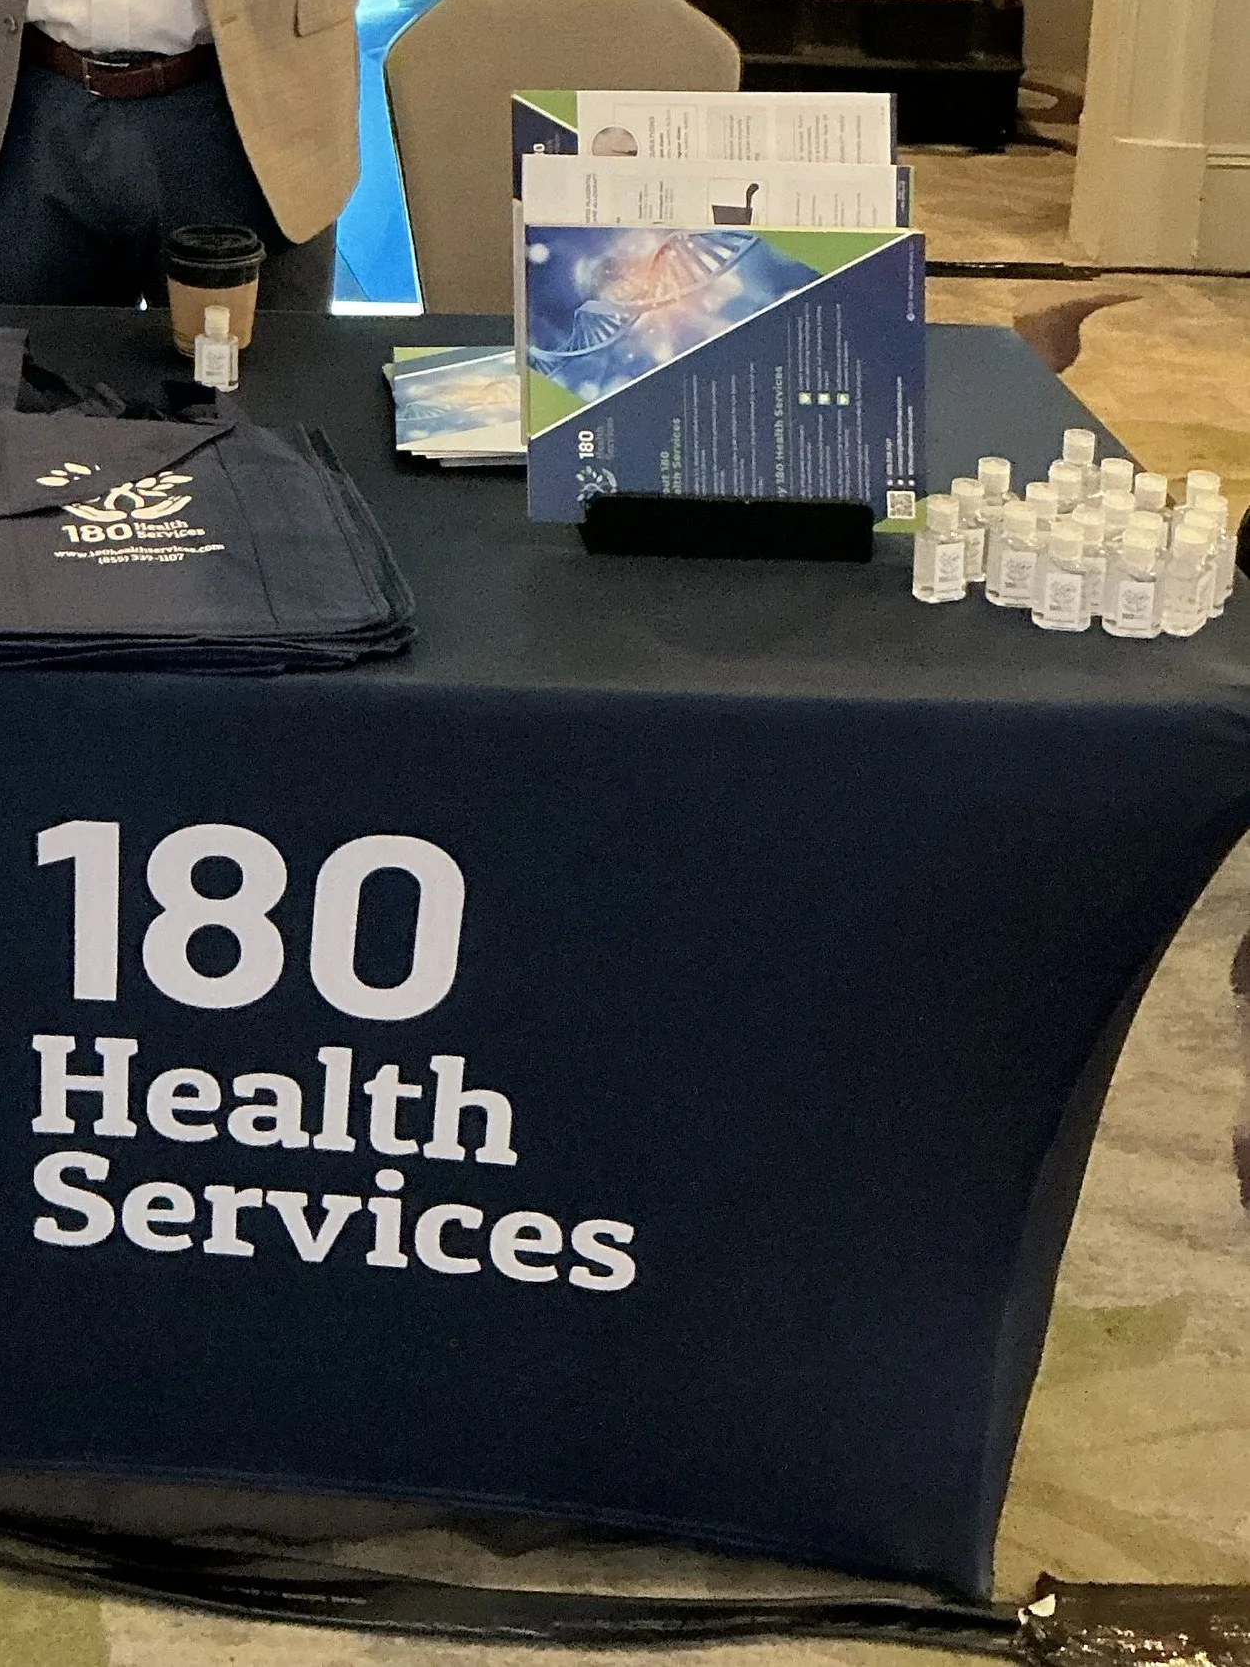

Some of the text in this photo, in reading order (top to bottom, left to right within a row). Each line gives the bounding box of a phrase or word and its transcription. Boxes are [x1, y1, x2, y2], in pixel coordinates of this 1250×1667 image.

[773, 366, 783, 417] Services
[578, 430, 594, 459] 180
[671, 417, 681, 494] alth Services
[61, 523, 133, 543] 180
[134, 520, 188, 531] Health
[137, 529, 205, 539] Services
[36, 820, 465, 1021] 180
[31, 1034, 517, 1166] Health
[33, 1150, 636, 1292] Services
